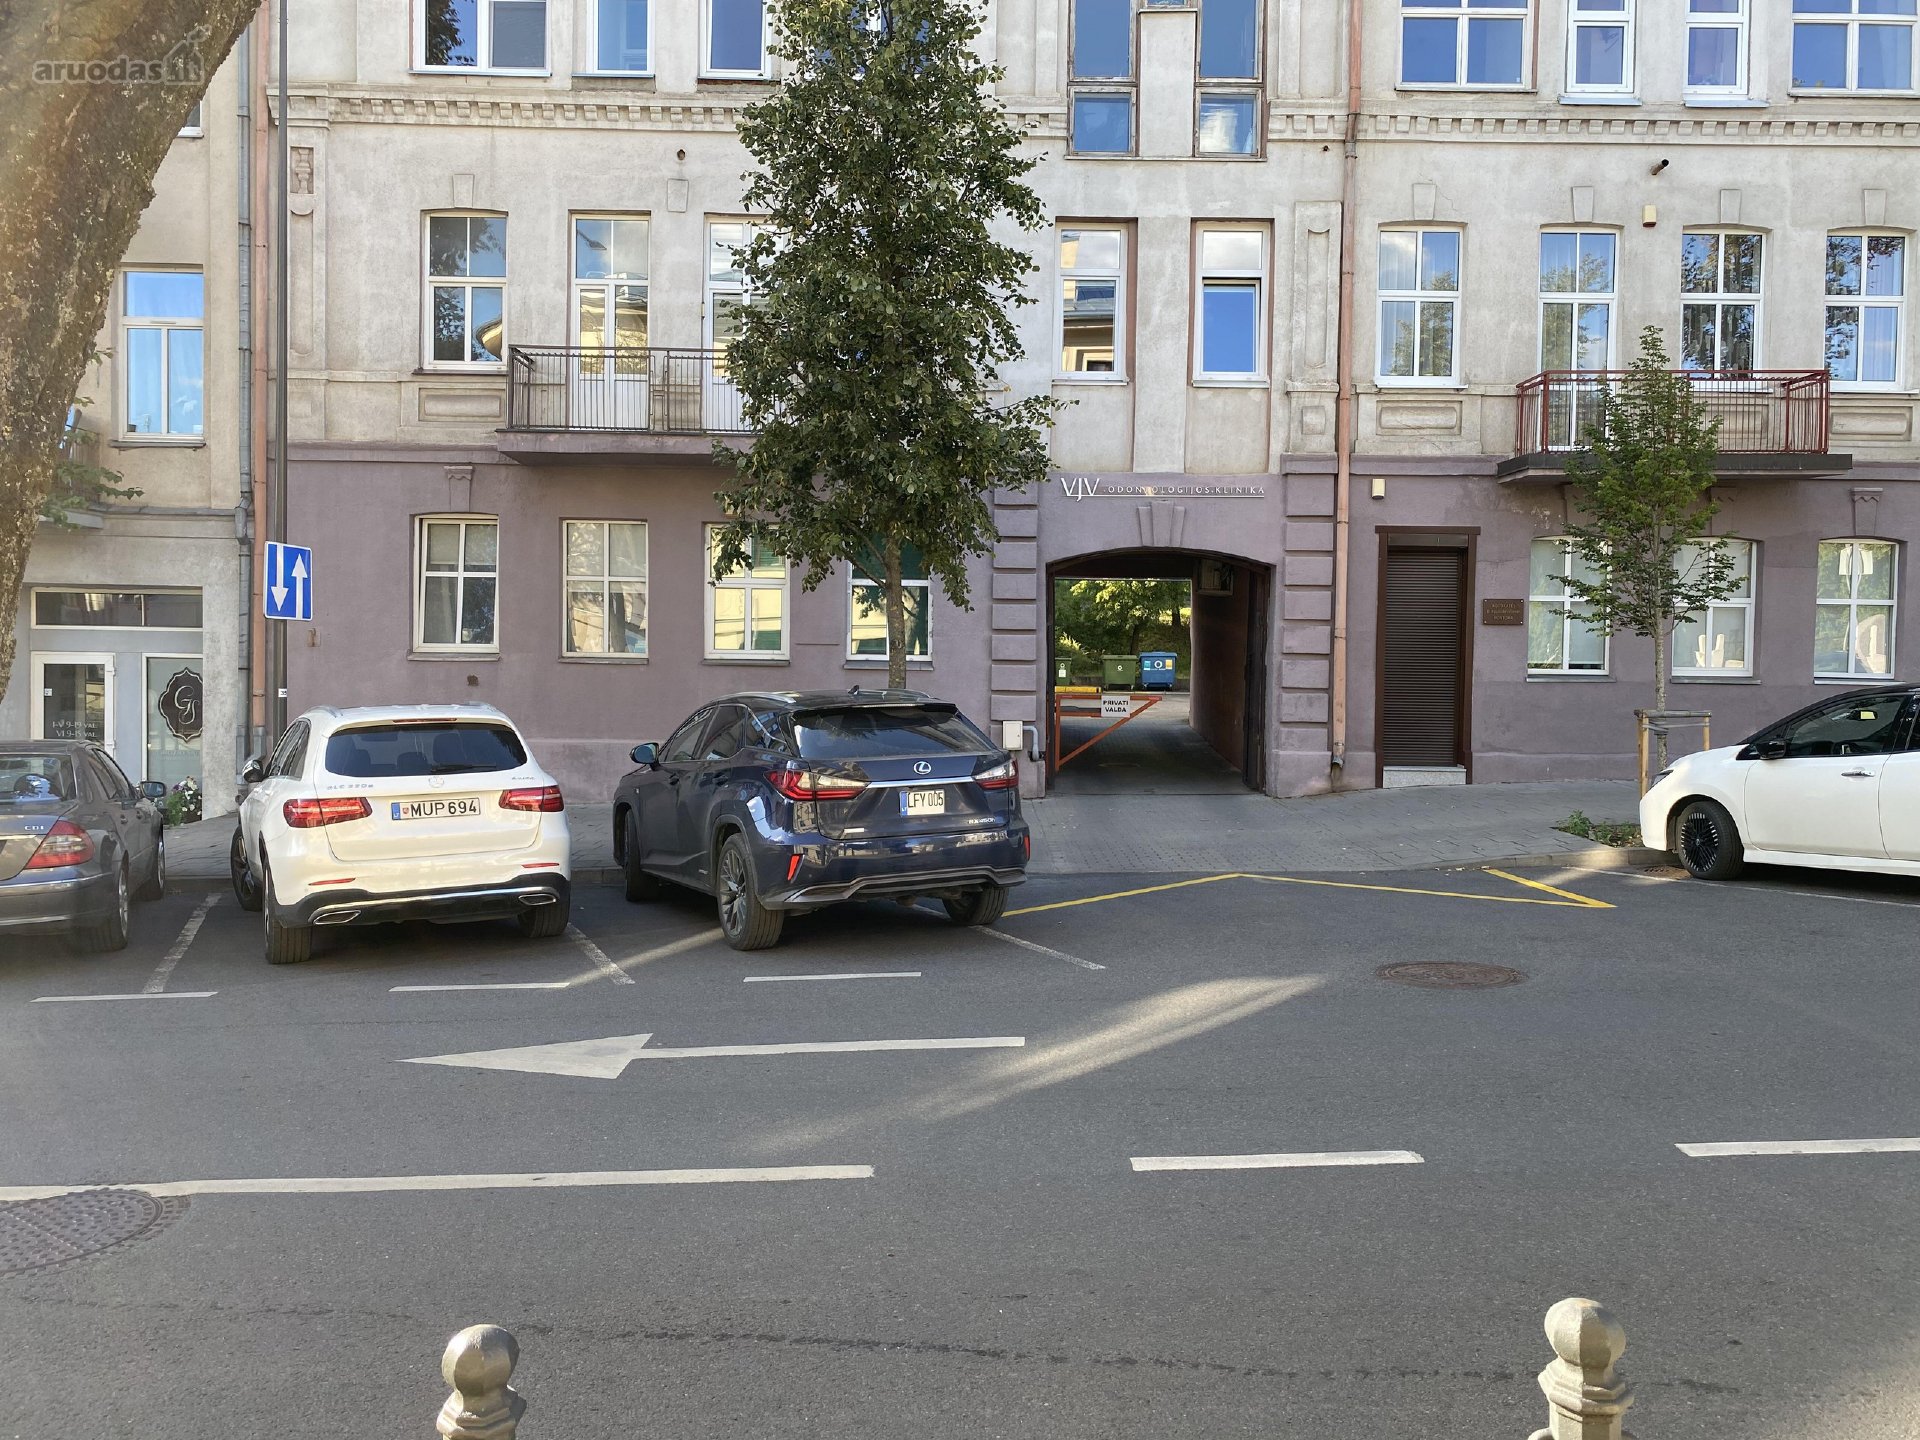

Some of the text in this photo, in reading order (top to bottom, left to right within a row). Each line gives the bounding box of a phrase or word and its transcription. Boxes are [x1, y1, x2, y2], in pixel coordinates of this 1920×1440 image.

[1061, 477, 1100, 502] VJV
[907, 792, 926, 808] LFY
[927, 791, 944, 807] 005
[410, 802, 445, 818] MUP
[448, 800, 477, 815] 694
